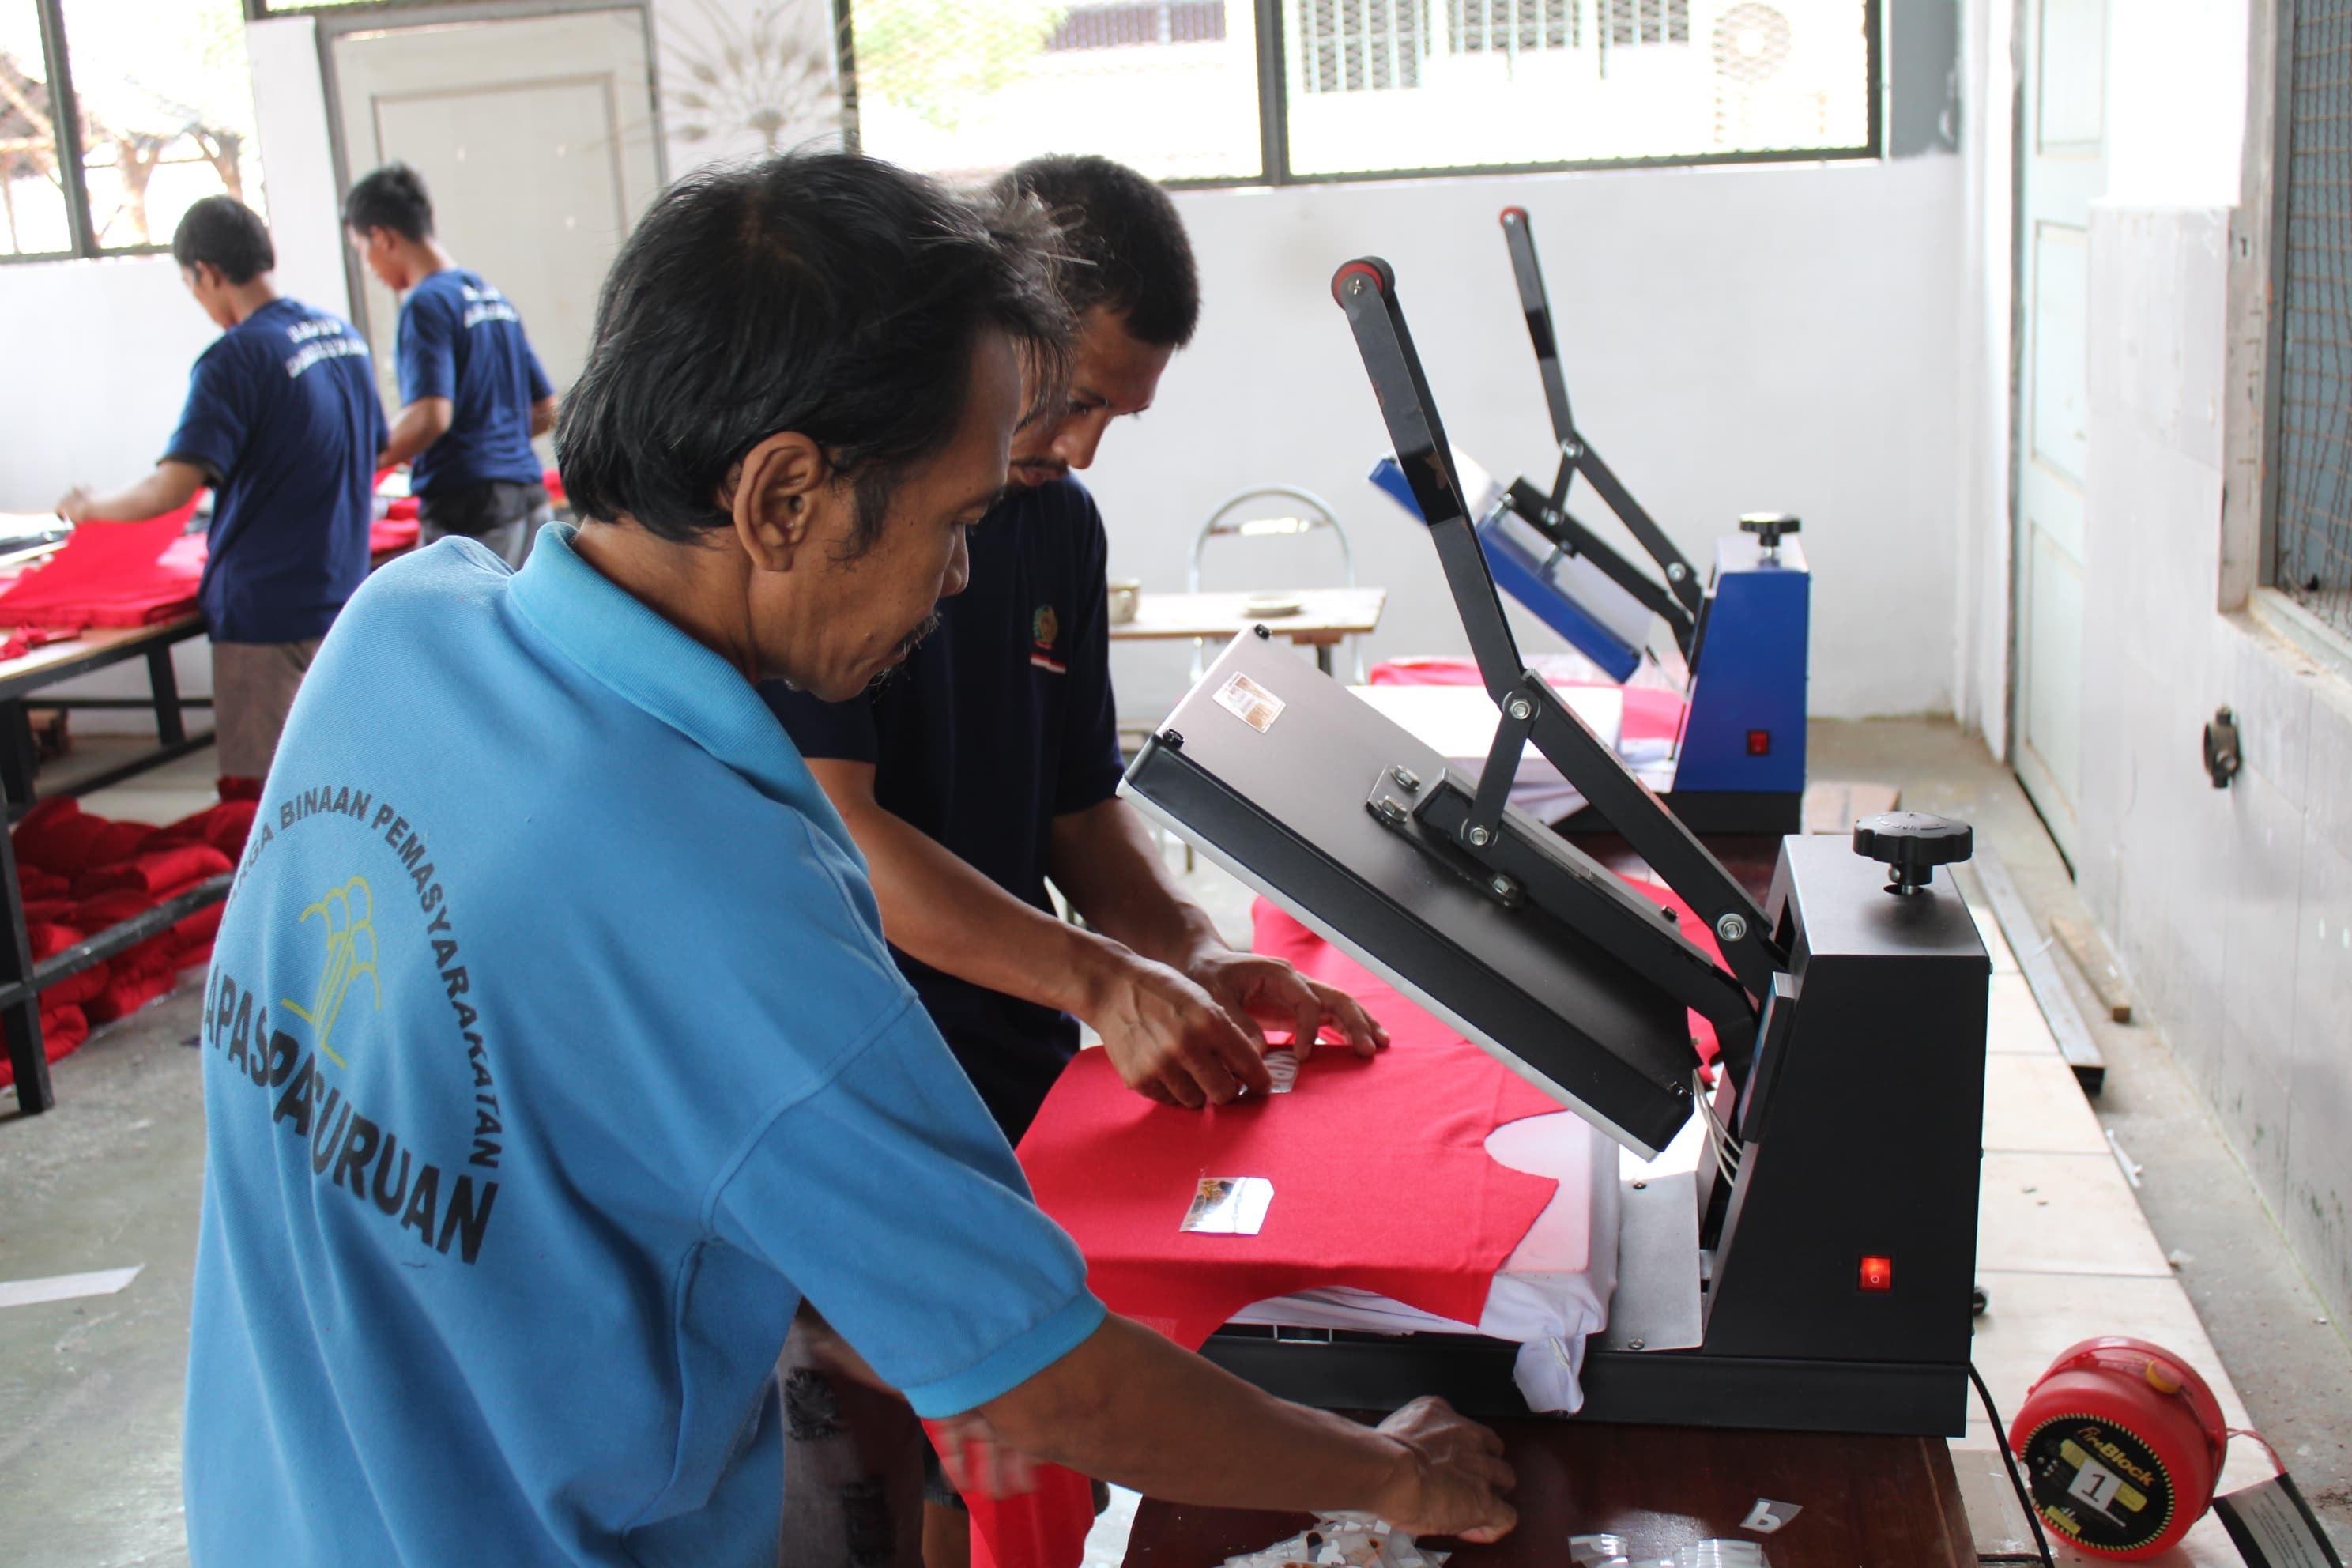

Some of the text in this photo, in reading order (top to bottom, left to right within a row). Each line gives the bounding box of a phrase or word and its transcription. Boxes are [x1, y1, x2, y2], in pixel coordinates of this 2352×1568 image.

[279, 785, 372, 831] BINAAN
[371, 803, 503, 1169] PEMASYARAKATAN
[2082, 1473, 2106, 1503] 1
